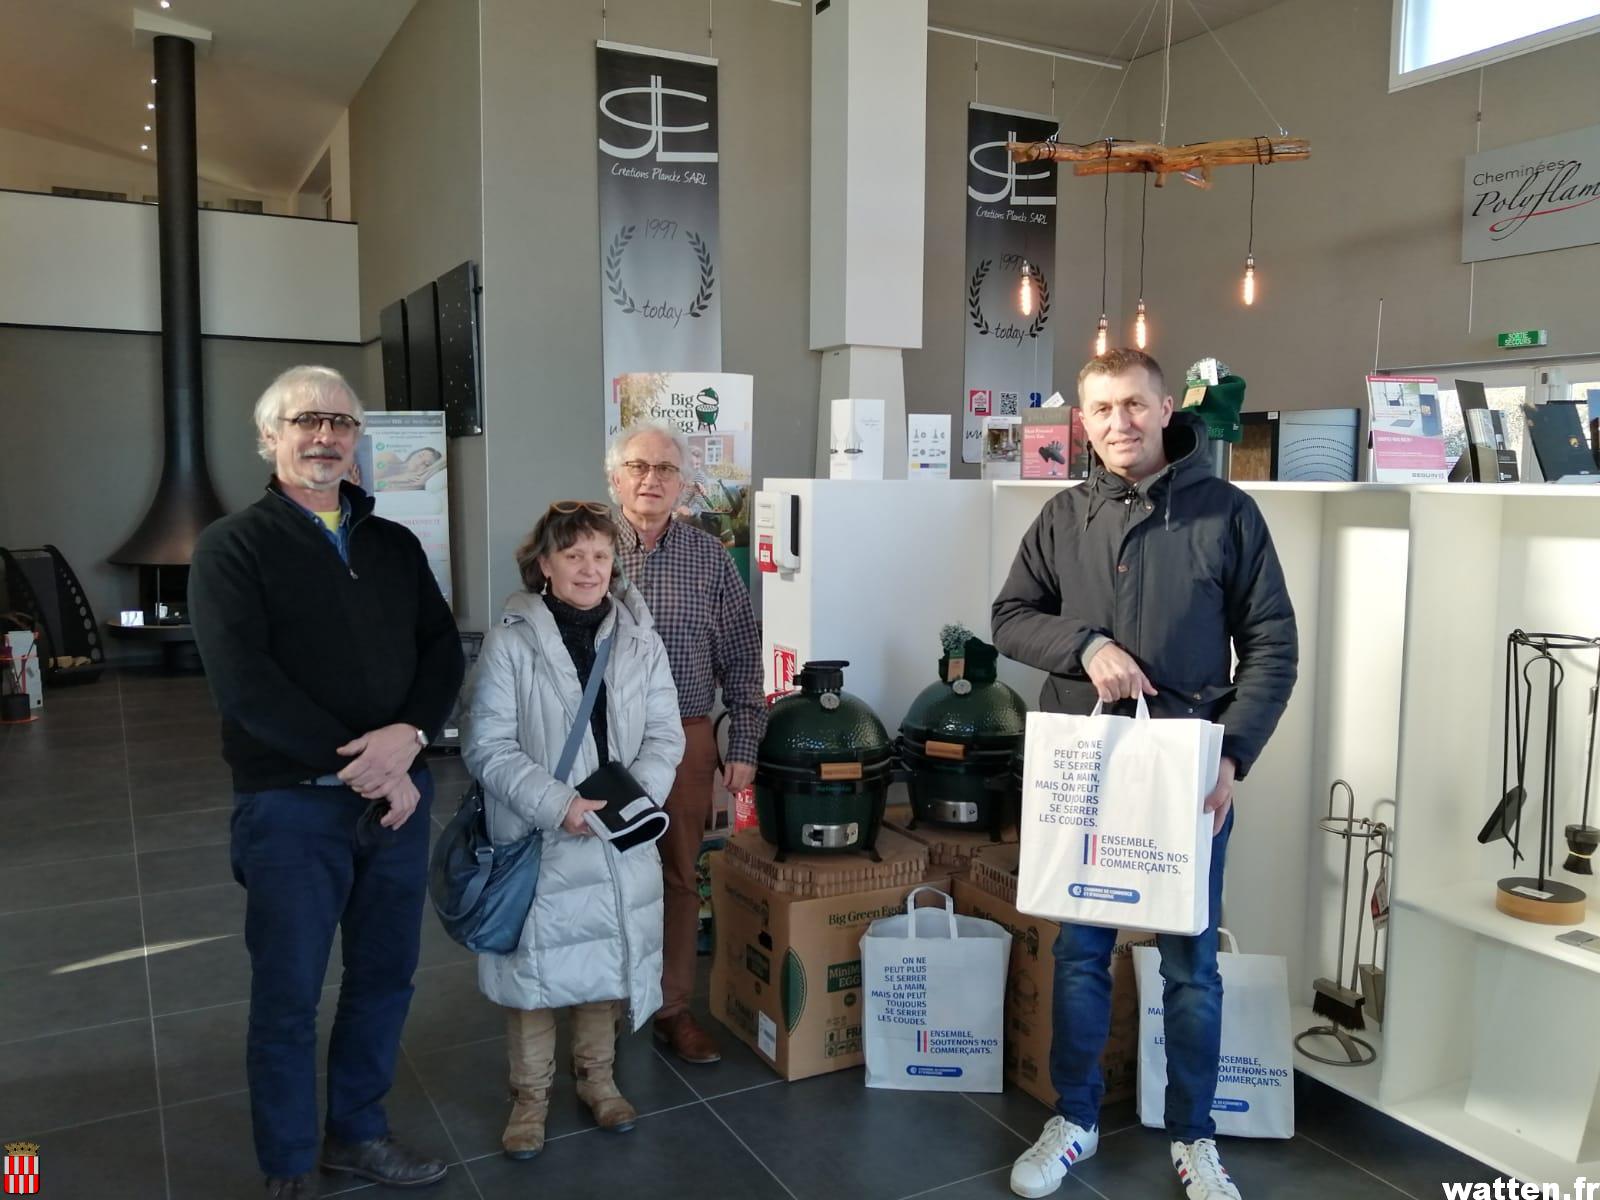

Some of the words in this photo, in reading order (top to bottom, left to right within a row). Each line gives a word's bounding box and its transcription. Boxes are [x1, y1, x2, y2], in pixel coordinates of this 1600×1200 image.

[683, 171, 708, 185] SARL
[1473, 159, 1566, 187] Cheminées
[645, 218, 678, 240] 1997
[642, 300, 682, 328] today
[995, 322, 1024, 347] today
[671, 393, 694, 408] Big
[651, 406, 694, 418] Green
[1078, 740, 1090, 749] ON
[1091, 740, 1103, 749] NE
[1054, 749, 1078, 759] PEUT
[1081, 751, 1102, 760] PLUS
[1053, 760, 1065, 770] SE
[1067, 761, 1101, 771] SERRER
[1062, 771, 1074, 781] LA
[1076, 772, 1101, 783] MAIN,
[1035, 780, 1059, 791] MAIS
[1061, 782, 1075, 792] ON
[1076, 783, 1100, 793] PEUT
[1052, 792, 1099, 804] TOUJOURS
[1049, 803, 1061, 814] SE
[1064, 804, 1098, 816] SERRER
[1039, 813, 1056, 824] LES
[1059, 815, 1098, 827] COUDES.
[1101, 834, 1158, 849] ENSEMBLE,
[1100, 846, 1164, 861] SOUTENONS
[1167, 852, 1189, 863] NOS
[1100, 857, 1181, 875] COMMERÇANTS.
[829, 913, 846, 926] Big
[848, 908, 880, 922] Green
[884, 966, 905, 974] PEUT
[906, 965, 927, 973] PLUS
[884, 974, 895, 982] SE
[896, 974, 927, 982] SERRER
[892, 983, 903, 991] LA
[904, 983, 927, 992] MAIN,
[871, 990, 891, 999] MAIS
[892, 991, 905, 1000] ON
[906, 991, 927, 999] PEUT
[886, 1000, 927, 1008] TOUJOURS
[885, 1007, 895, 1015] SE
[896, 1008, 927, 1017] SERRER
[1148, 1007, 1164, 1016] MAI
[877, 1014, 892, 1023] LES
[893, 1016, 928, 1026] COUDES.
[930, 1030, 974, 1039] ENSEMBLE,
[1154, 1036, 1165, 1045] LE
[930, 1038, 979, 1047] SOUTENONS
[980, 1039, 998, 1047] NOS
[930, 1047, 993, 1056] COMMERÇANTS.
[1218, 1055, 1262, 1066] NSEMBLE,
[1217, 1066, 1267, 1076] OUTENONS
[1269, 1068, 1288, 1077] NOS
[1218, 1075, 1282, 1087] OMMERÇANTS.
